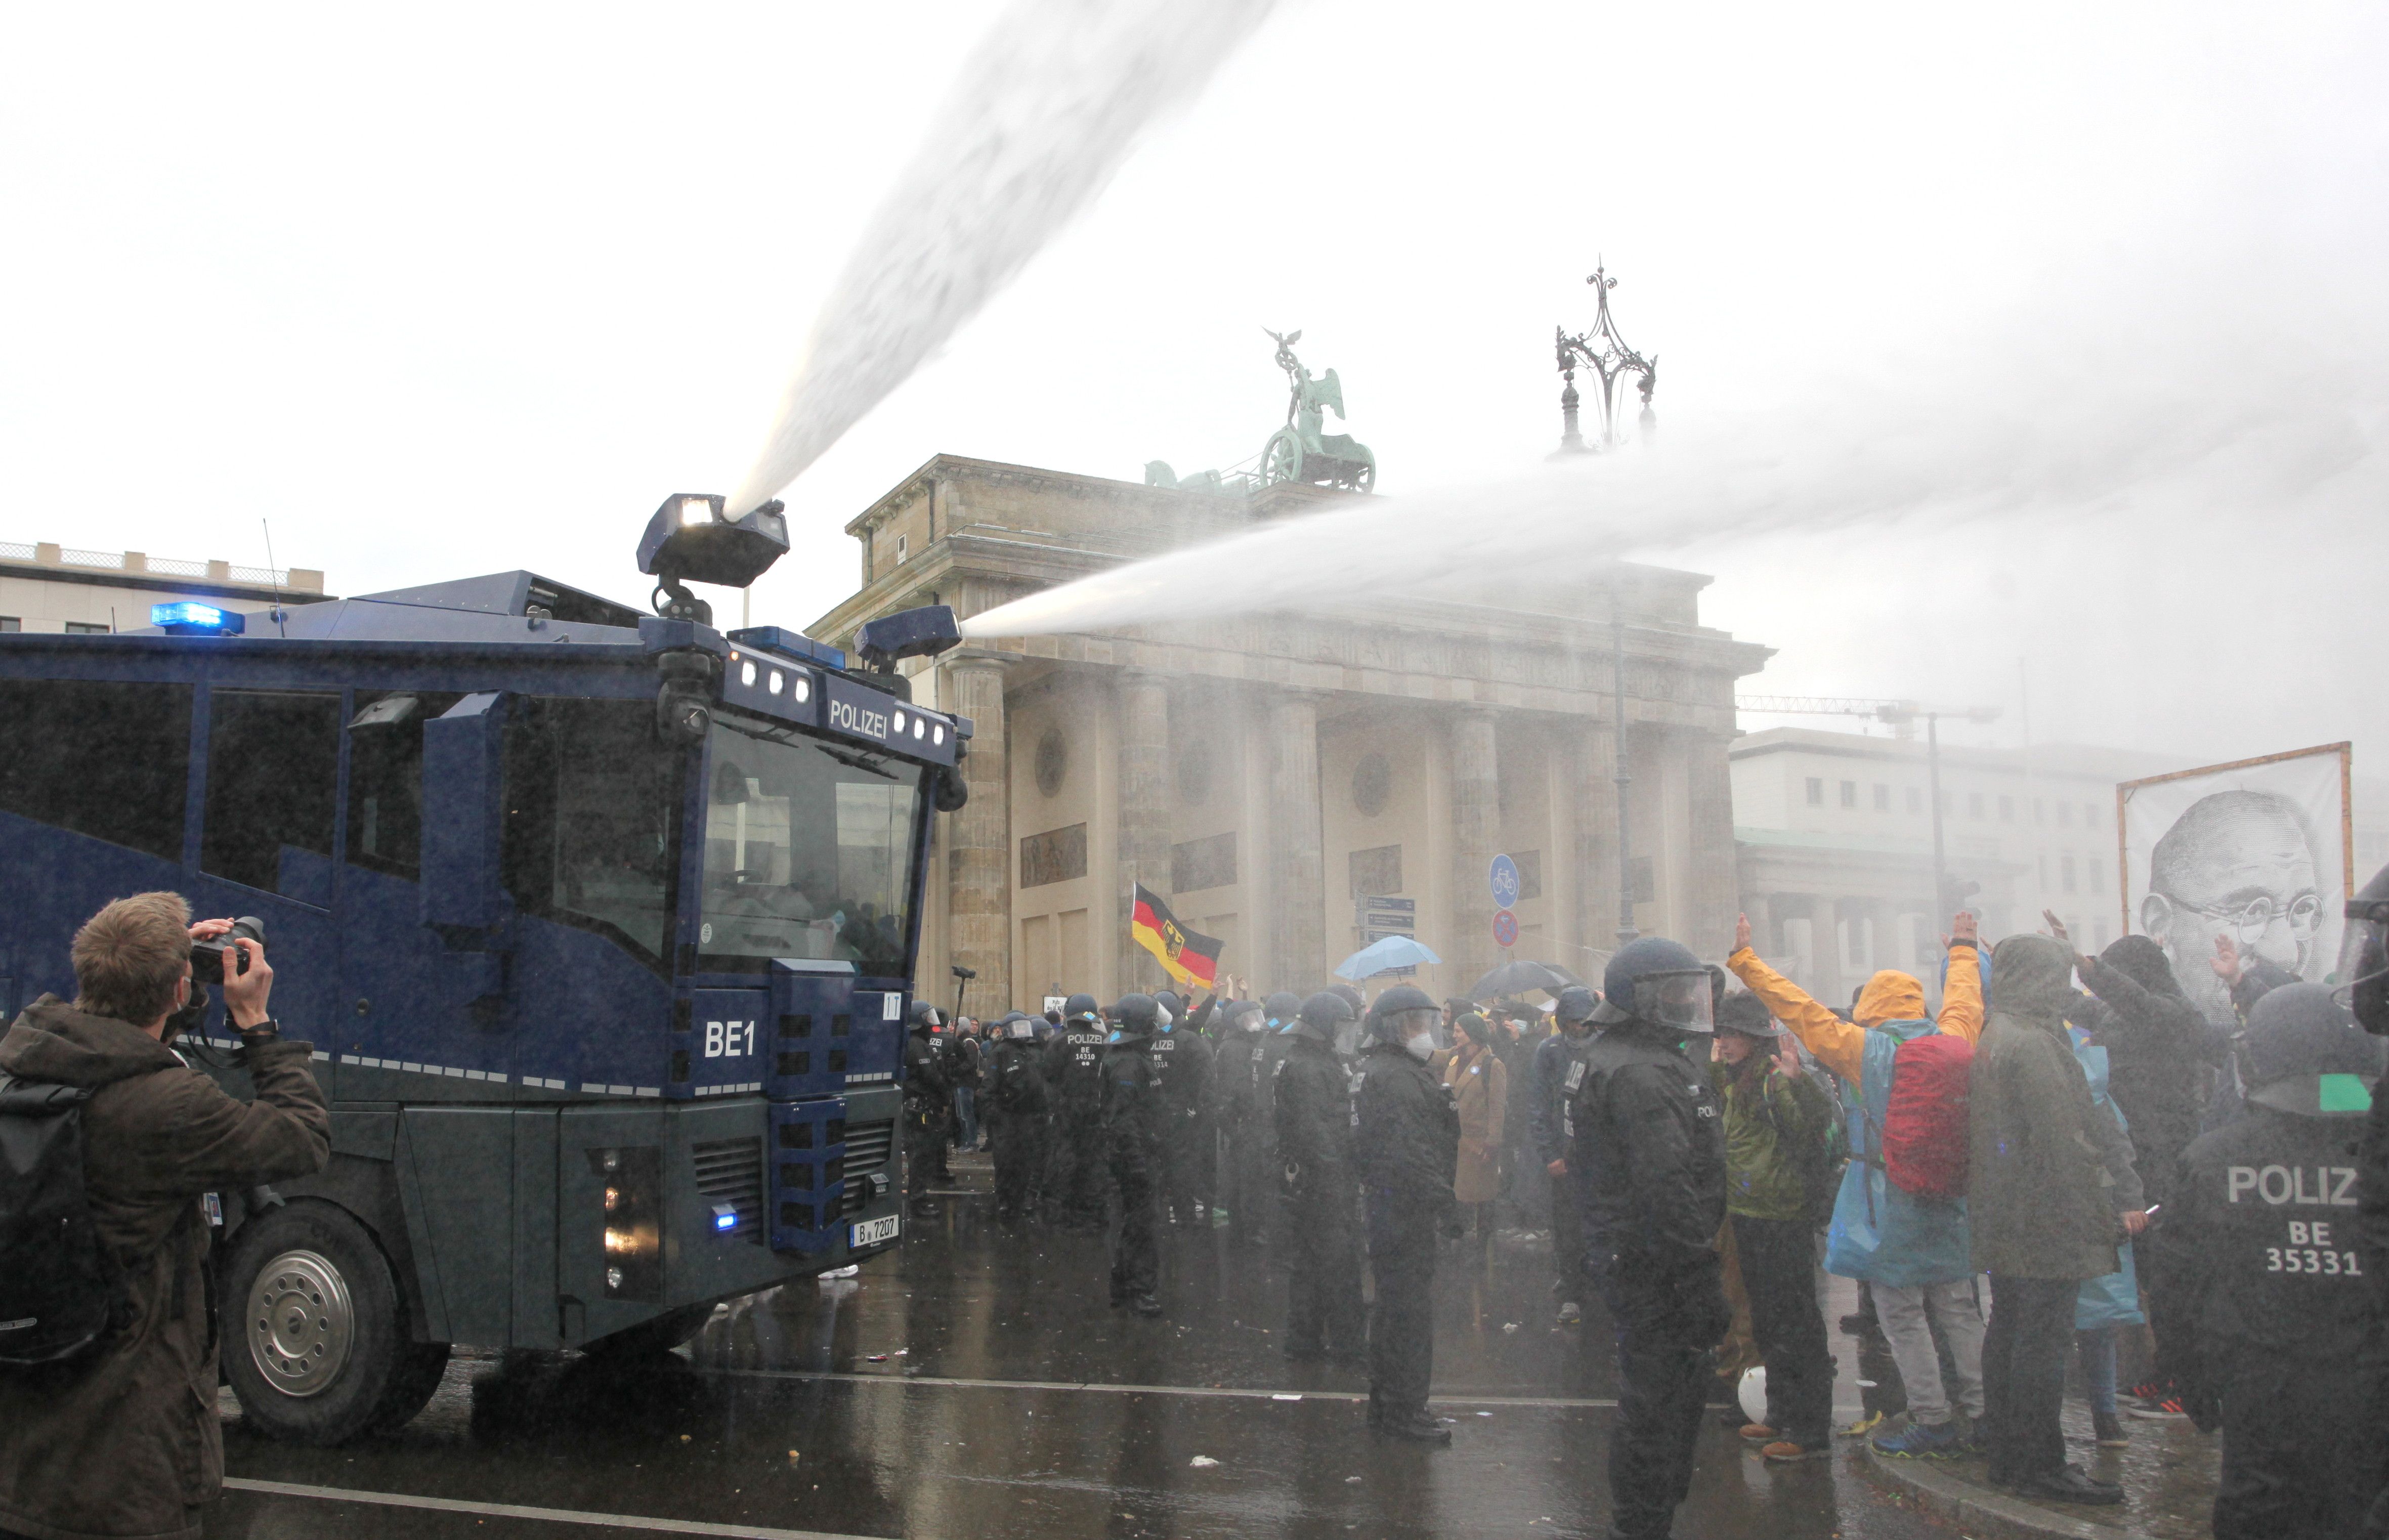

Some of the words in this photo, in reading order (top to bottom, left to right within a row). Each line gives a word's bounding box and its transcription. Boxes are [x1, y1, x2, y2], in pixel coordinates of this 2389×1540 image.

[830, 699, 887, 739] POLIZEI
[705, 1020, 755, 1057] BE1
[1068, 1034, 1102, 1044] POLIZEI
[2228, 1165, 2358, 1206] POLIZ
[860, 1225, 865, 1242] B
[874, 1218, 894, 1238] 7207
[2288, 1221, 2332, 1246] BE
[2266, 1248, 2362, 1275] 35331
